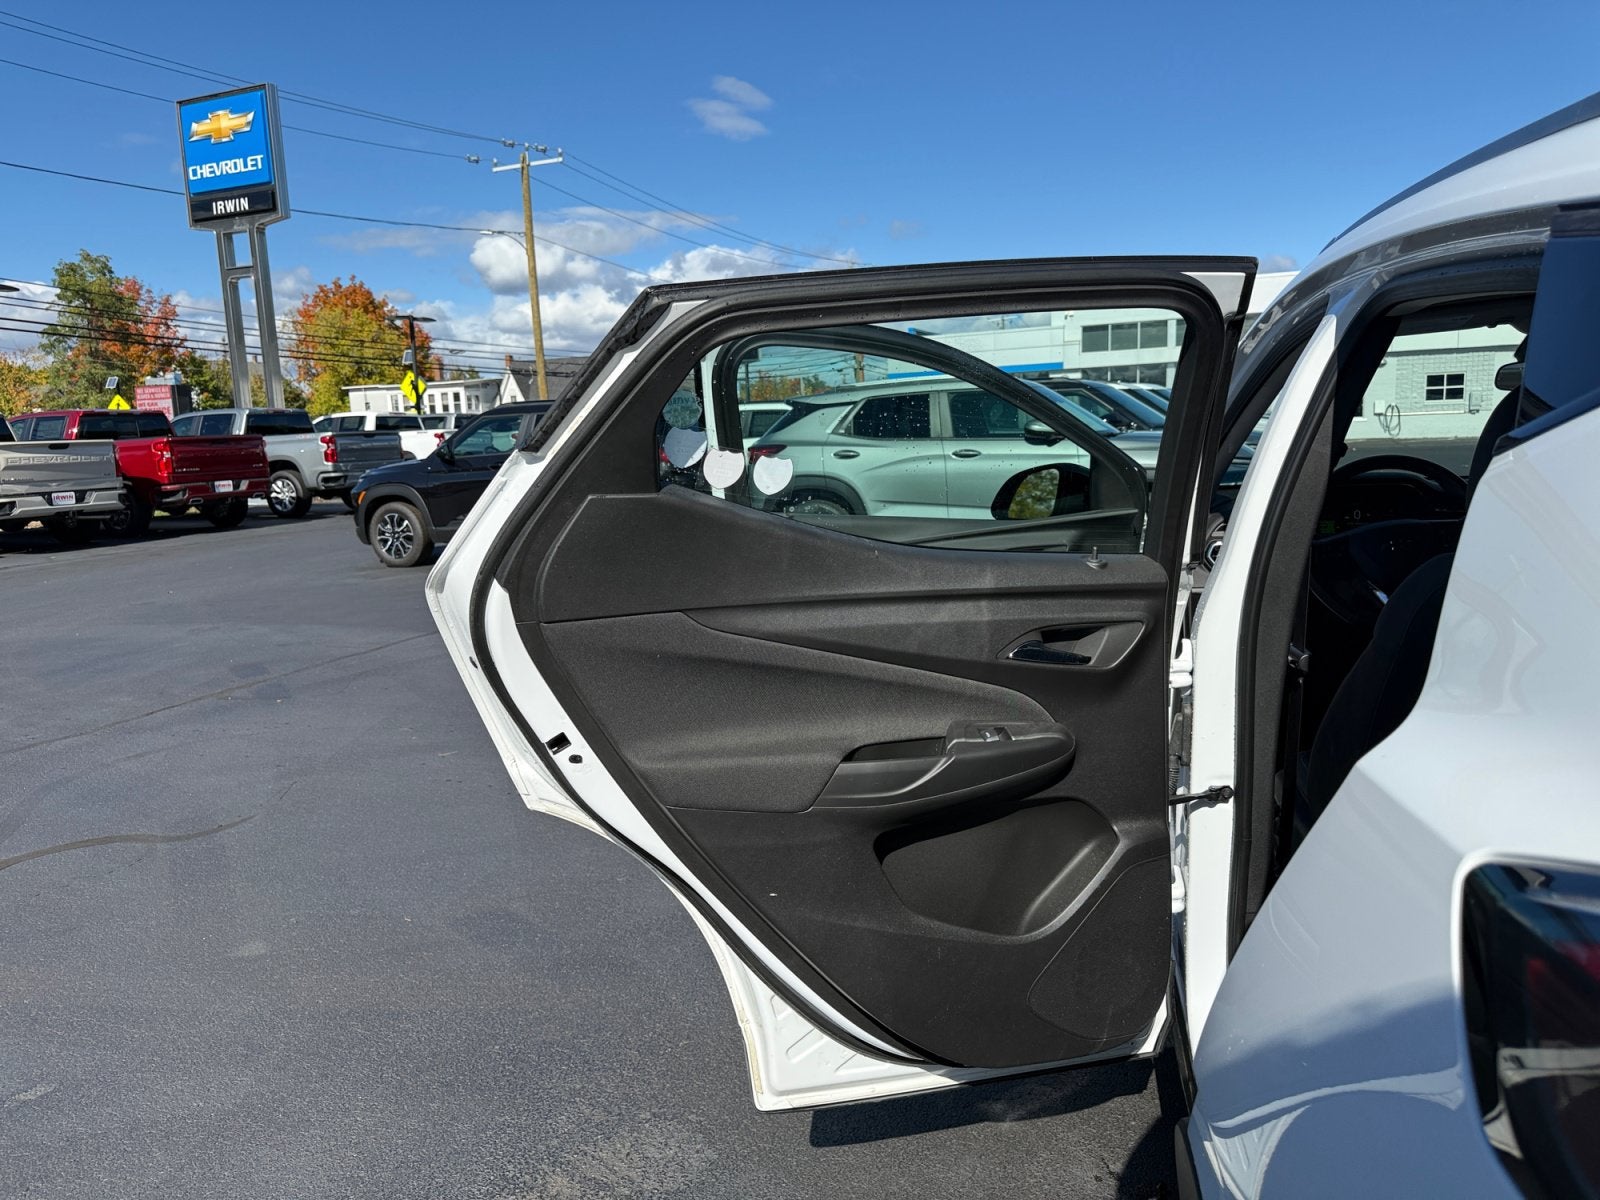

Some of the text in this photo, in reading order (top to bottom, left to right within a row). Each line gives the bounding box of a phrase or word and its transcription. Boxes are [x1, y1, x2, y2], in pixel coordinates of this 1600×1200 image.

[188, 154, 264, 180] CHEVROLET
[212, 197, 249, 215] IRWIN
[7, 455, 112, 465] CHEVROLET
